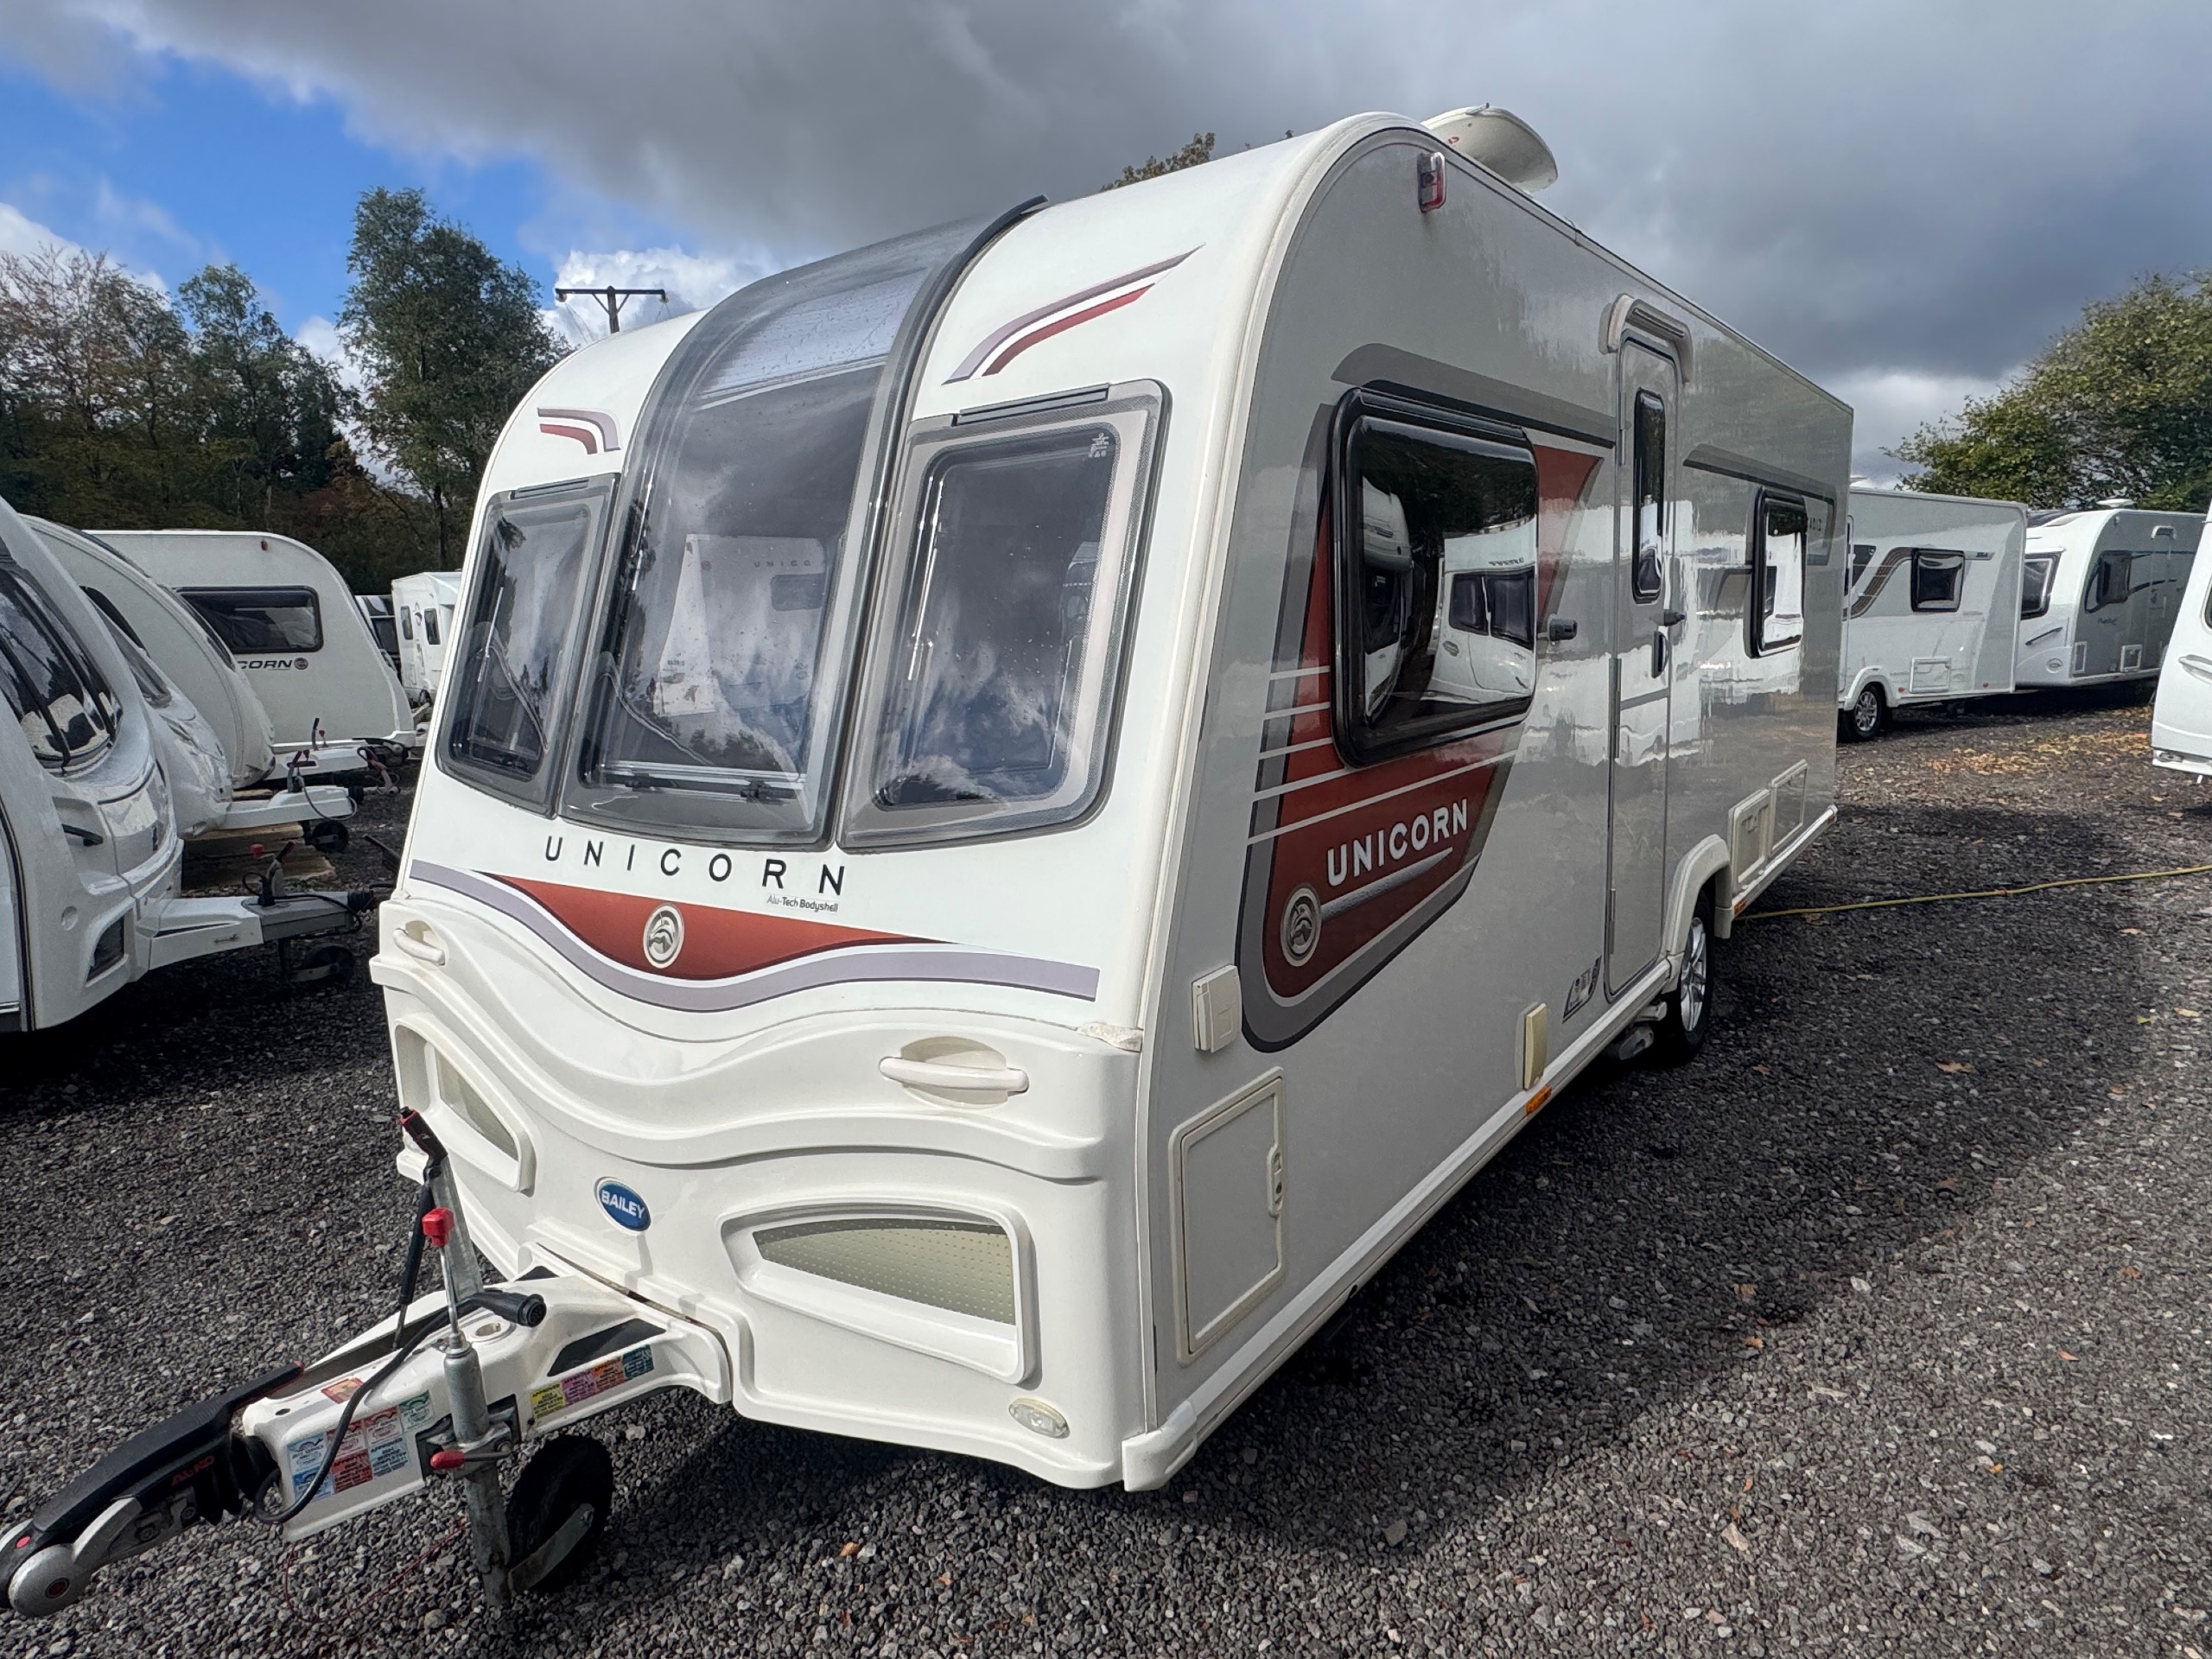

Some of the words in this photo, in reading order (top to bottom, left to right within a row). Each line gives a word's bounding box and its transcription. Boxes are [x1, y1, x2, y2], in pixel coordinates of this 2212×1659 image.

[1326, 798, 1468, 887] UNICORN
[544, 836, 846, 895] UNICORN
[766, 895, 798, 907] Alu-Tech
[799, 899, 839, 912] Bodyshell
[601, 1189, 645, 1218] BAILEY
